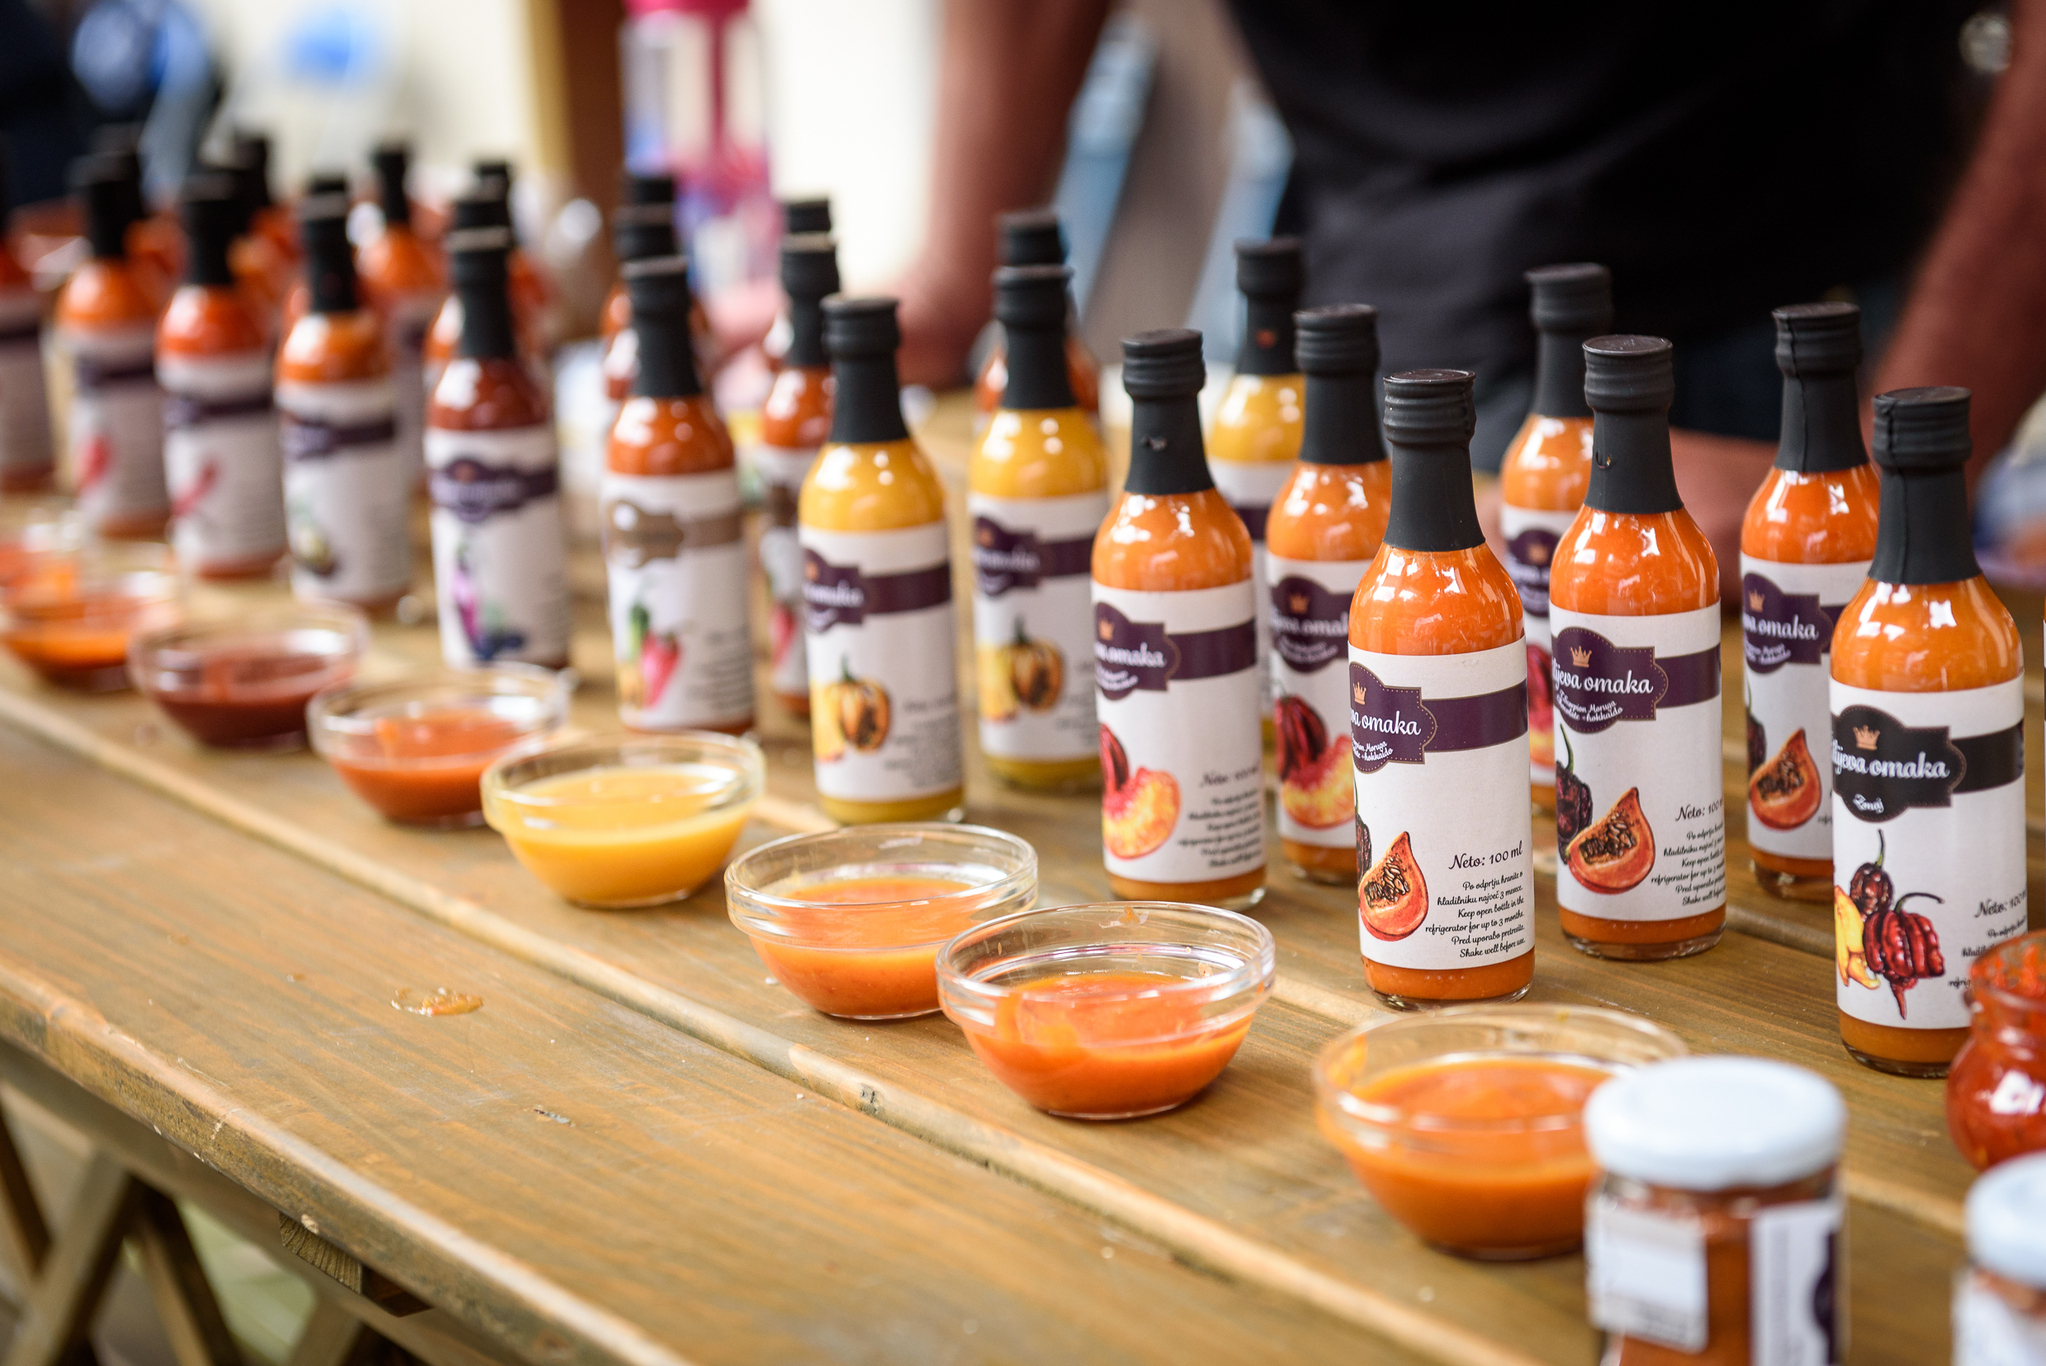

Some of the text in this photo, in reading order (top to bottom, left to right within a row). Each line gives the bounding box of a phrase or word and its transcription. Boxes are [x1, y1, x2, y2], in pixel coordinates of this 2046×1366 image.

[1758, 613, 1820, 640] omaka
[1583, 669, 1654, 694] omaka
[1361, 710, 1422, 735] omaka
[1869, 750, 1951, 779] omaka
[1675, 803, 1706, 822] Neto:
[1852, 793, 1885, 814] Zmaj
[1448, 839, 1523, 870] Neto: 100 ml
[1462, 881, 1475, 891] Po
[1475, 878, 1501, 891] odprtju
[1437, 894, 1478, 906] hladilniku
[1499, 891, 1505, 900] 3
[1457, 895, 1524, 920] Keep open bottle in the
[1974, 898, 2008, 918] Neto:
[1425, 923, 1468, 935] refrigerator
[1468, 921, 1480, 933] for
[1481, 921, 1490, 931] up
[1490, 918, 1498, 926] to
[1498, 918, 1504, 927] 3
[1451, 934, 1471, 946] Pred
[1472, 931, 1501, 946] uporabo
[1459, 947, 1484, 958] Shake
[1484, 944, 1499, 955] well
[1499, 940, 1516, 953] before
[1962, 944, 1986, 957] hladil
